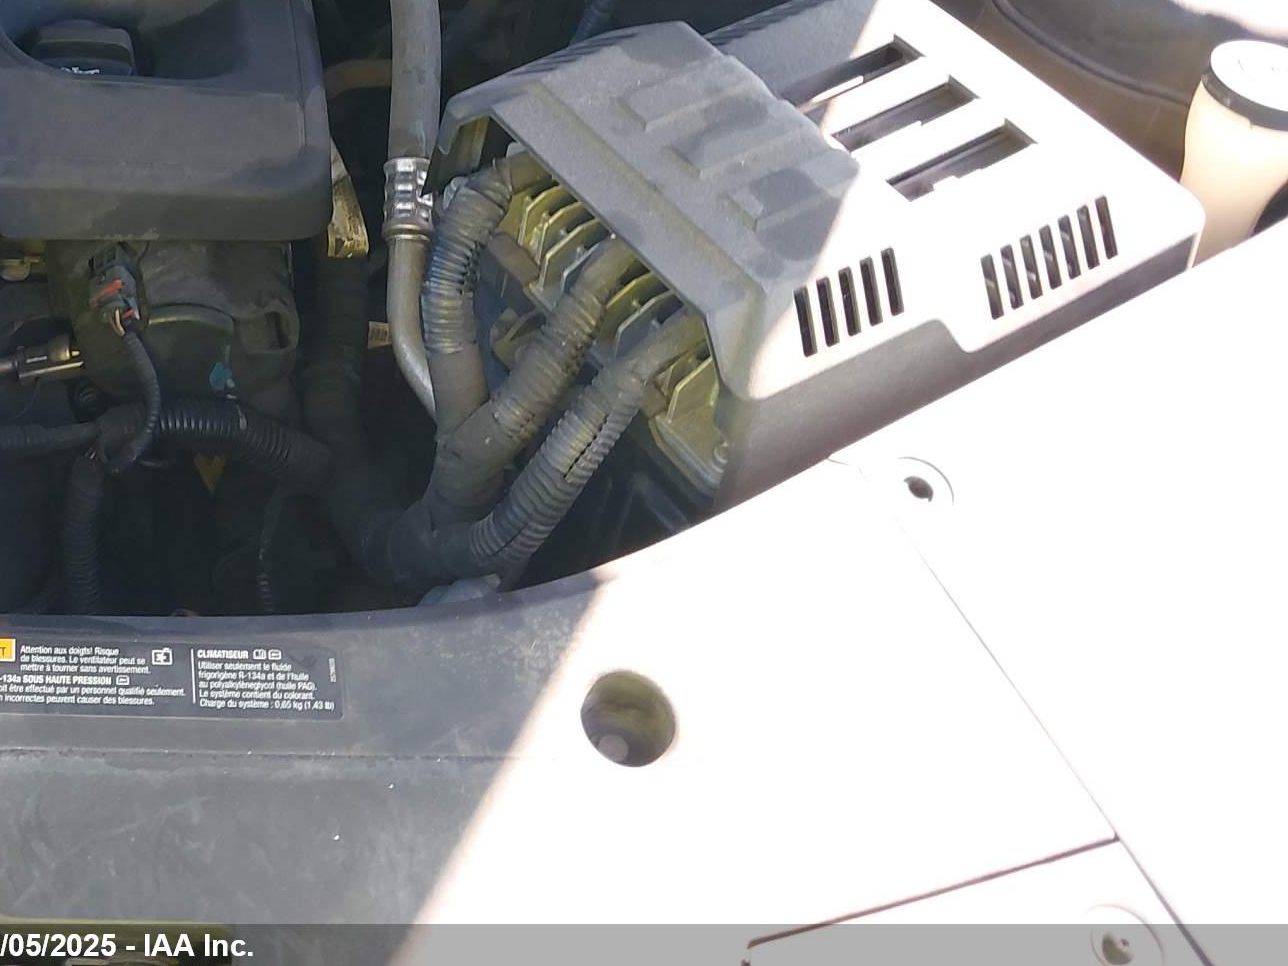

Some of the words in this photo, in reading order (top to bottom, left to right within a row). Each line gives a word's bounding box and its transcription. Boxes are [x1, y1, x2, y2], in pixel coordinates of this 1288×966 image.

[20, 645, 52, 654] Attention
[54, 647, 67, 655] aux
[68, 646, 93, 656] doigts!
[94, 647, 119, 656] Risque
[197, 649, 249, 659] CLIMATISEUR
[20, 654, 30, 663] de
[31, 655, 67, 664] blessures.
[80, 656, 117, 664] ventilateur
[119, 657, 135, 665] peut
[98, 665, 151, 674] avertissement.
[198, 660, 222, 669] Utiliser
[224, 662, 262, 670] seulement
[263, 662, 270, 671] le
[271, 662, 292, 671] fluide
[22, 675, 44, 683] SOUS
[45, 675, 71, 684] HAUTE
[72, 676, 112, 685] PRESSION
[238, 671, 265, 680] R-134a
[267, 672, 274, 680] et
[276, 672, 285, 680] de
[56, 686, 68, 694] par
[81, 686, 117, 695] personnel
[146, 687, 186, 696] seulement.
[199, 689, 209, 698] Le
[242, 690, 271, 699] contient
[272, 690, 282, 699] du
[4, 695, 45, 703] incorrectes
[46, 696, 75, 704] peuvent
[76, 696, 101, 704] causer
[102, 696, 116, 704] des
[118, 696, 155, 705] blessures.
[200, 698, 226, 709] Charge
[227, 699, 237, 708] du
[293, 701, 303, 711] kg
